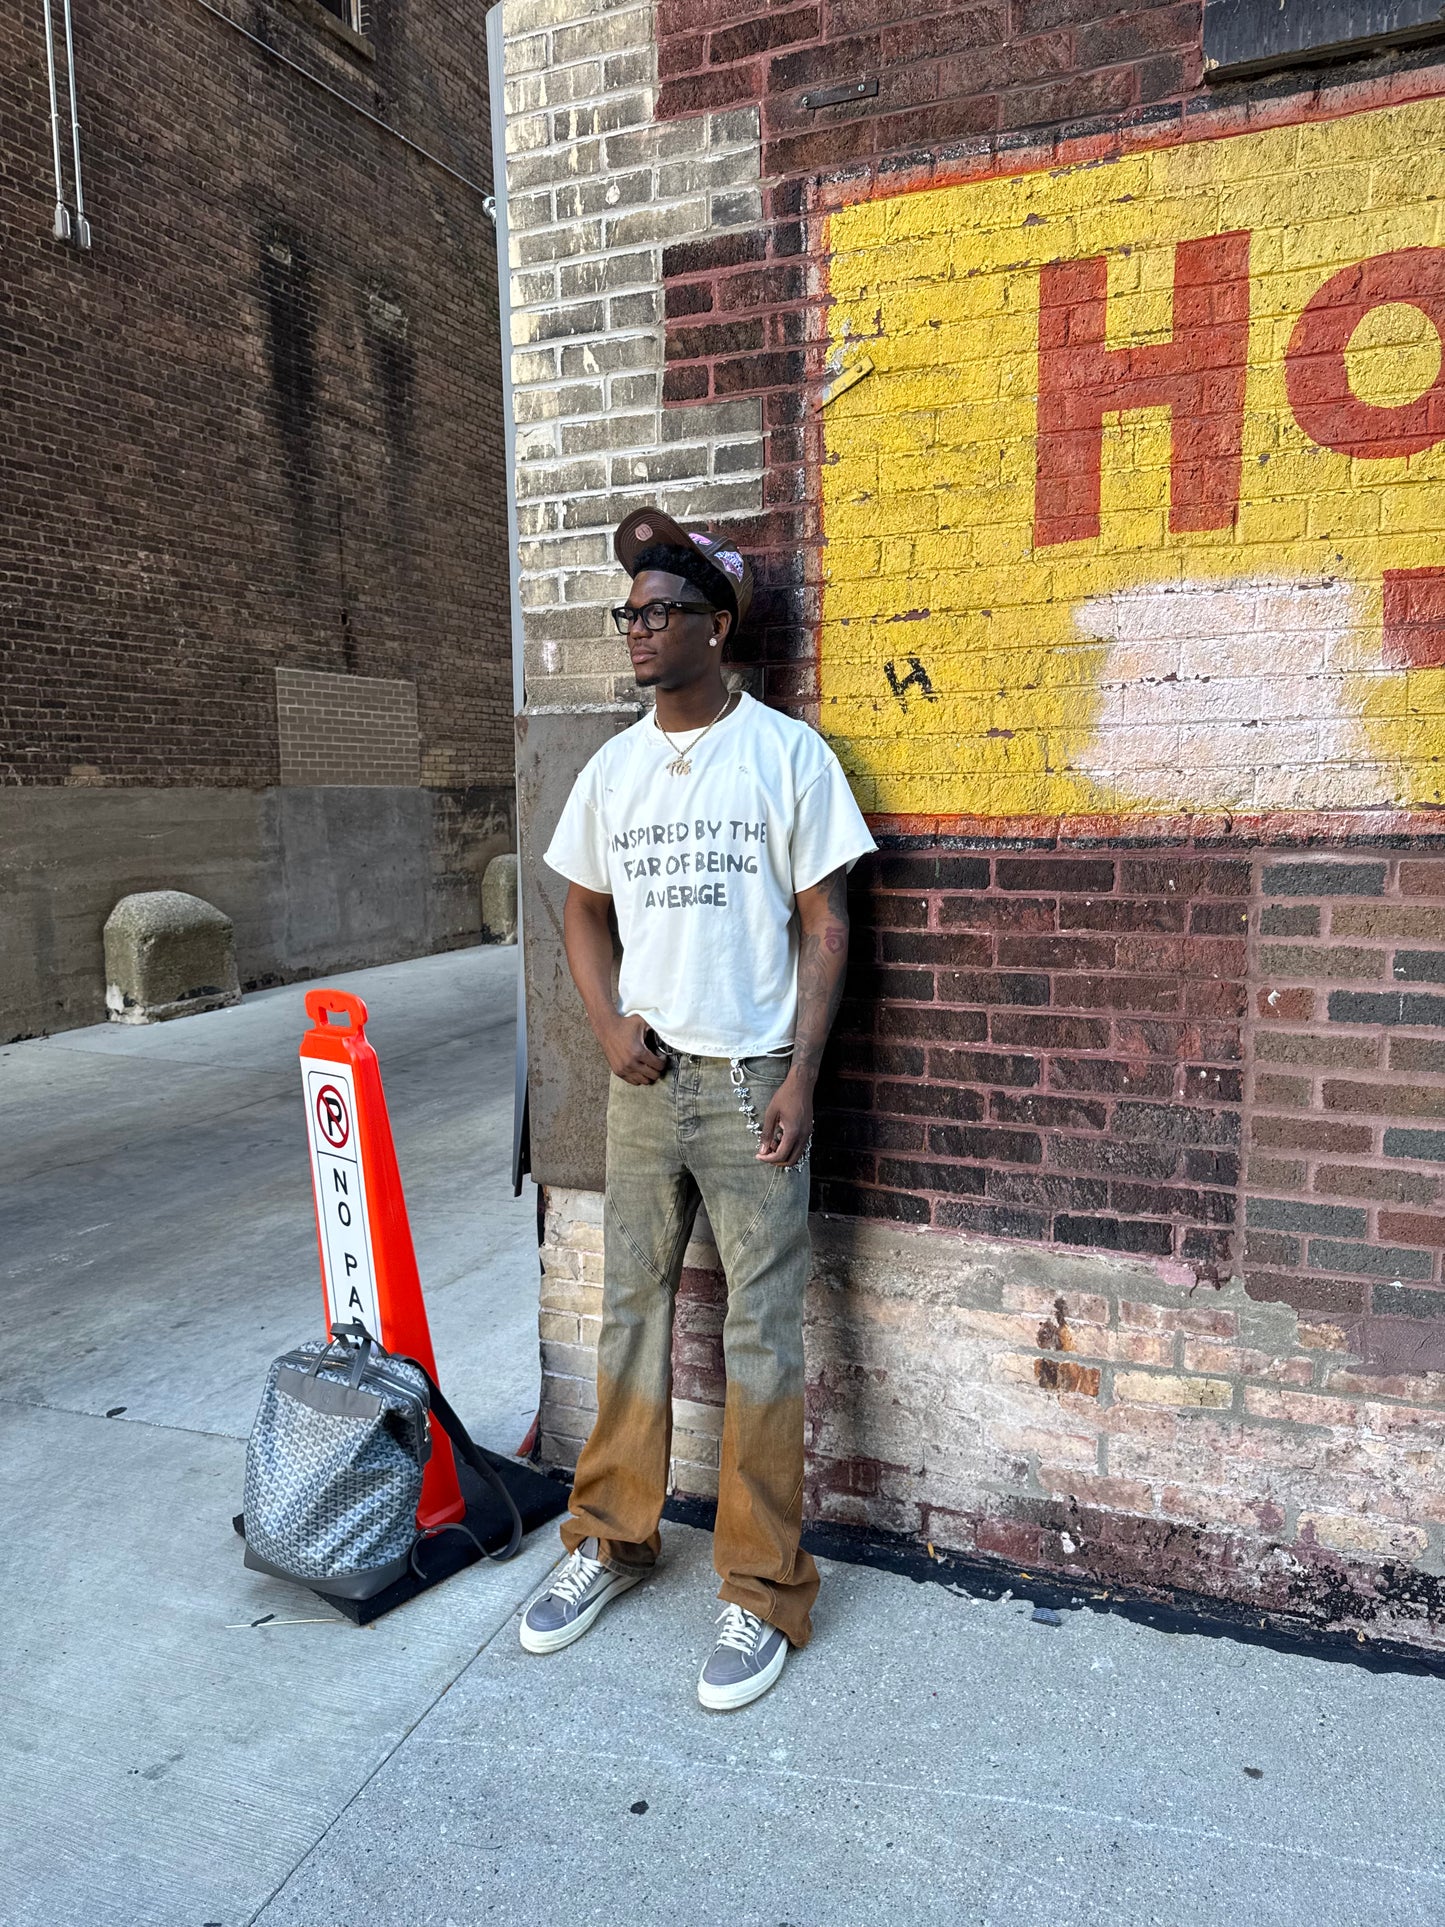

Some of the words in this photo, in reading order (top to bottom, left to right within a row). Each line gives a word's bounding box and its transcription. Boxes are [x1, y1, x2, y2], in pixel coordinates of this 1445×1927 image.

[611, 822, 689, 853] INSPIRED
[695, 819, 722, 840] BY
[729, 820, 767, 843] THE
[623, 857, 662, 882] FAR
[665, 853, 691, 876] OF
[695, 851, 758, 874] BEING
[645, 882, 728, 908] AVERAGE
[333, 1167, 352, 1227] NO
